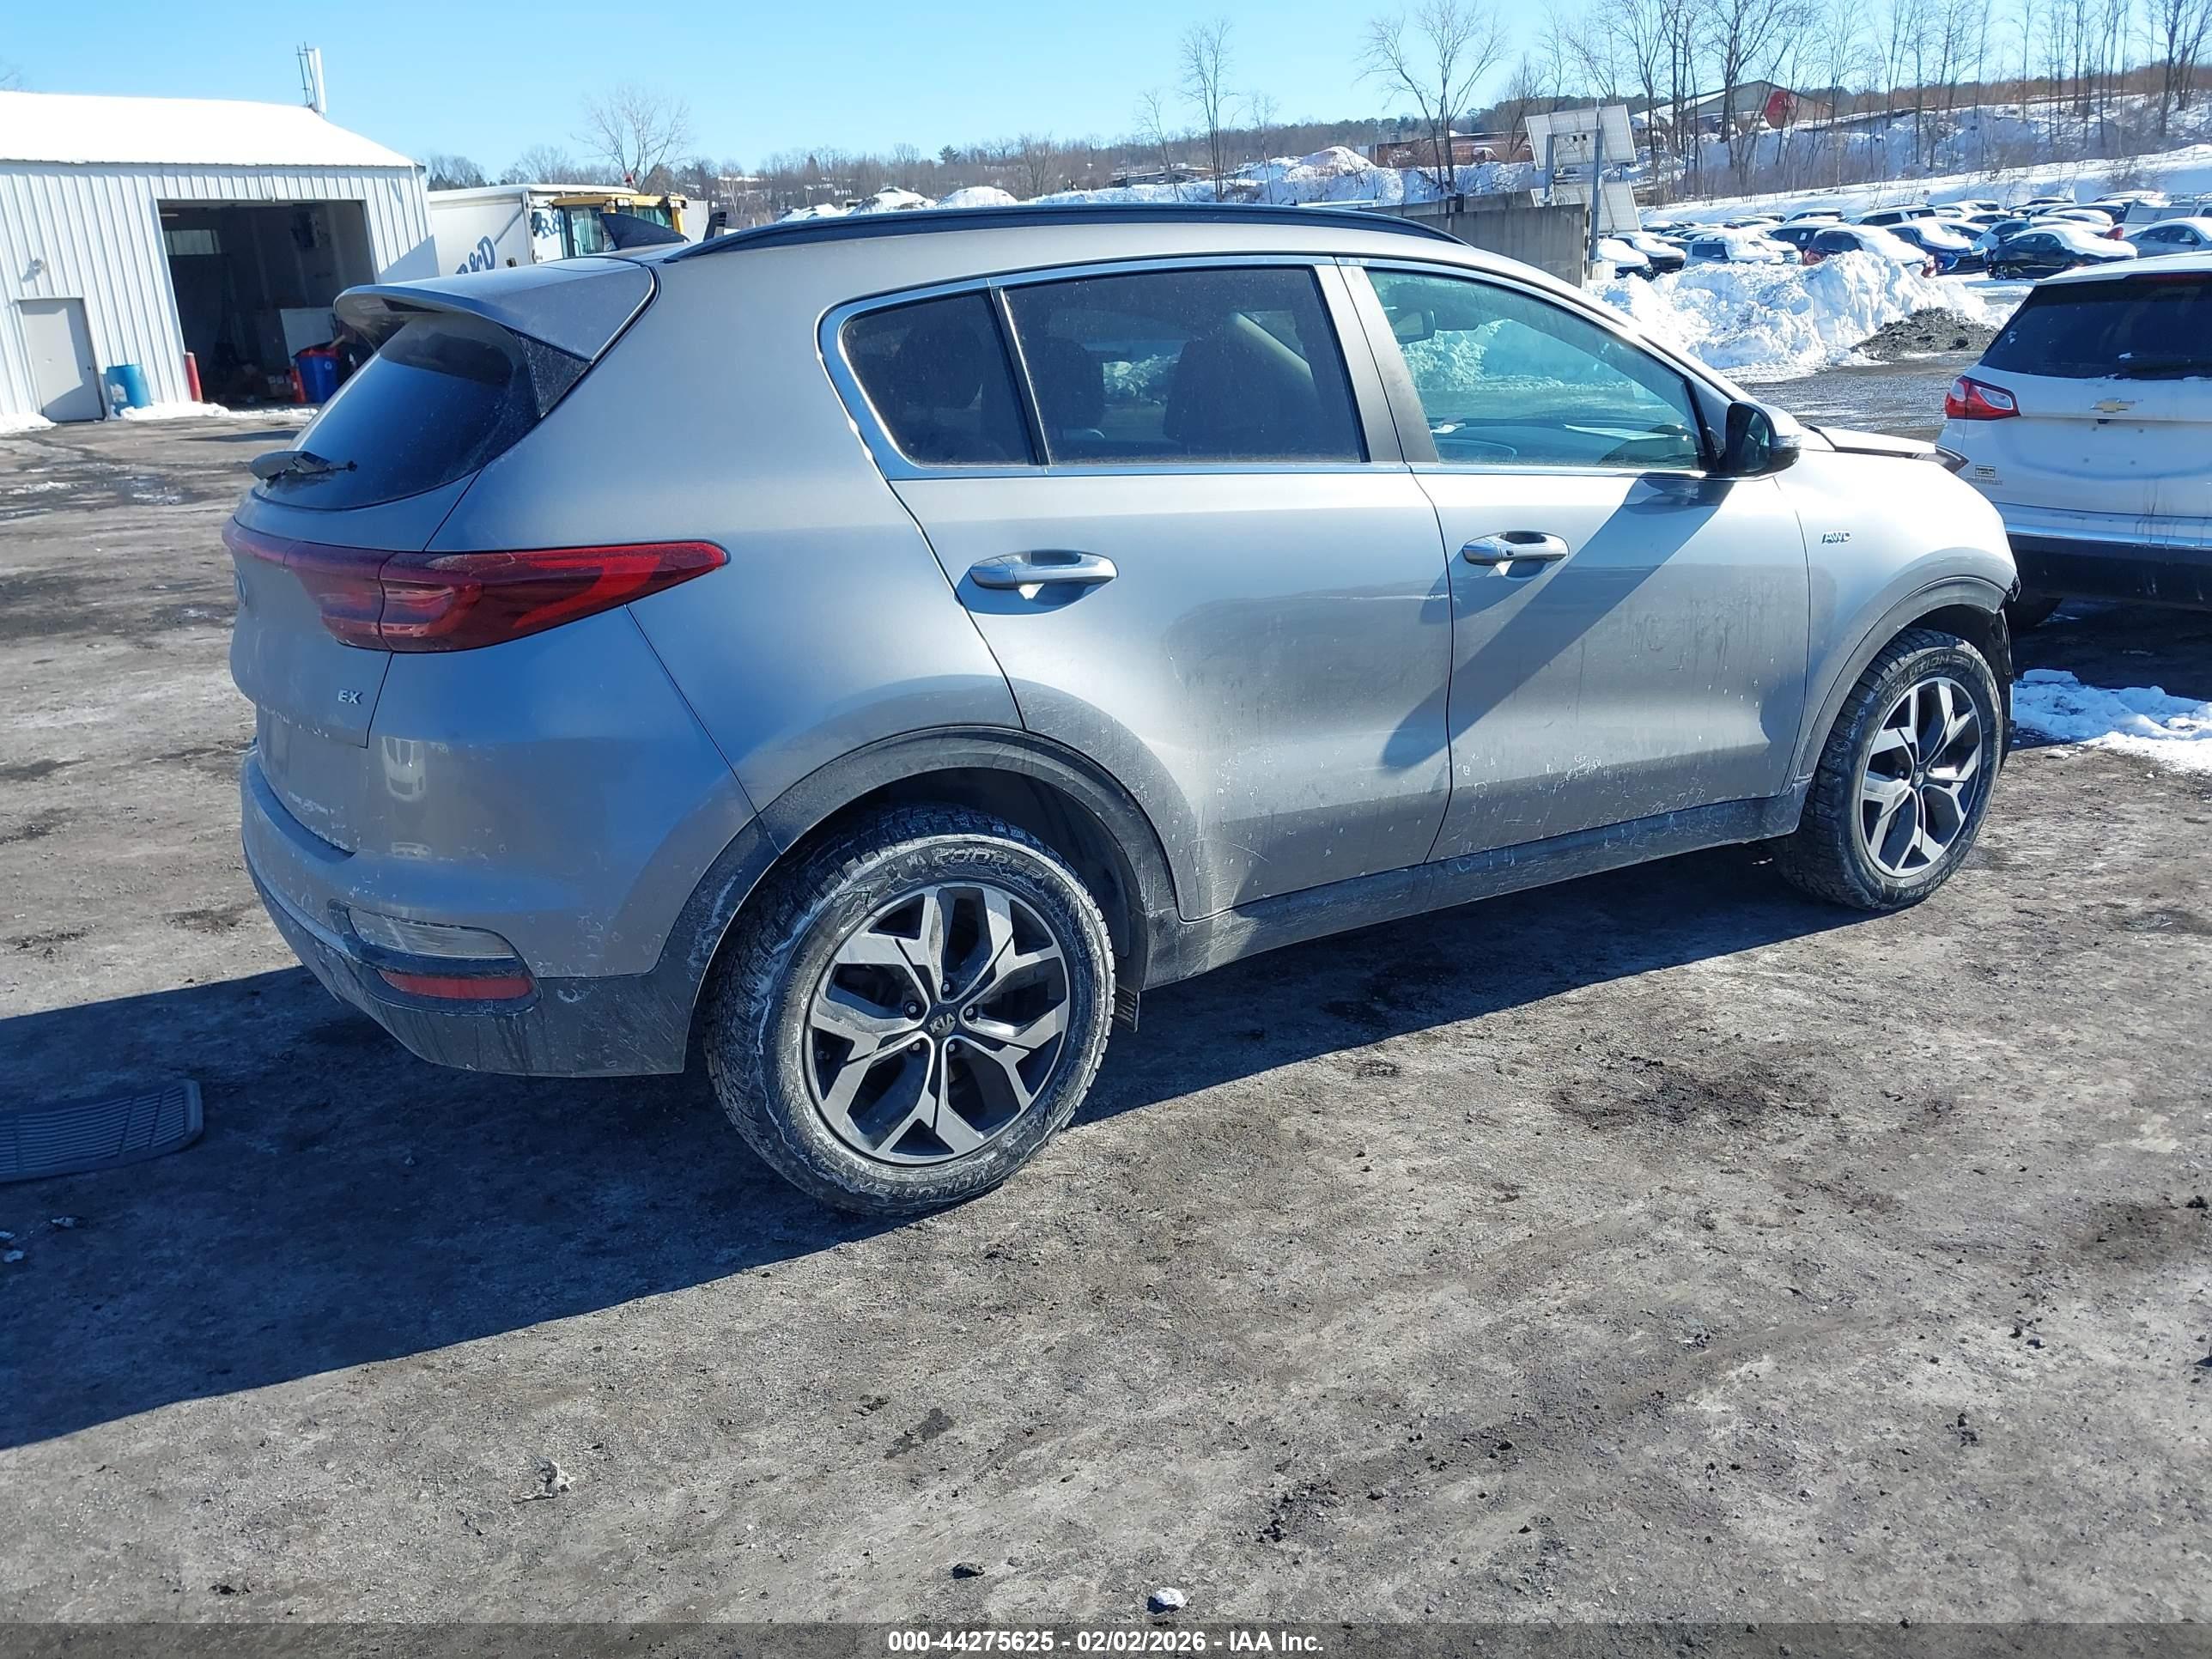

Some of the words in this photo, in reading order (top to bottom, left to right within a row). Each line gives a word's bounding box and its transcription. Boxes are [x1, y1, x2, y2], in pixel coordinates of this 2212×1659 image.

[1821, 532, 1853, 544] AWD
[338, 690, 362, 704] EX
[929, 1012, 956, 1034] KIA
